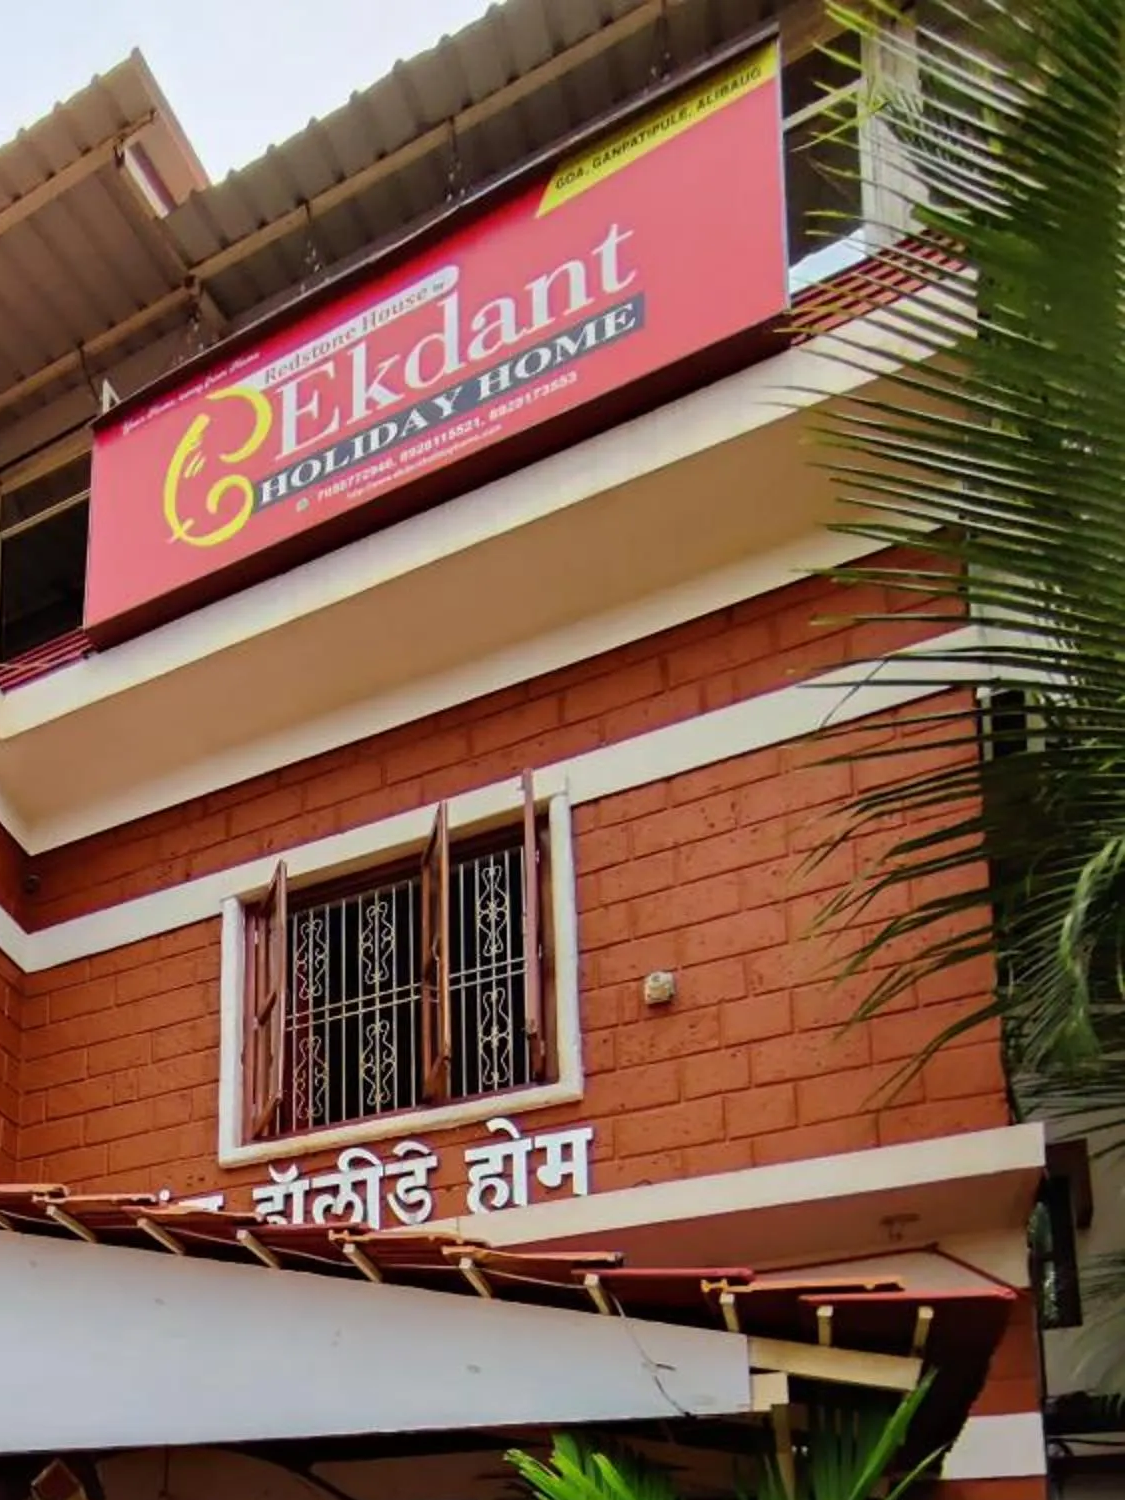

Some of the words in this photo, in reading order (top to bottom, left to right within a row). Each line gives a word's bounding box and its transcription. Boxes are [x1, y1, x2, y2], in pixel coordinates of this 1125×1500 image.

[259, 385, 464, 504] HOLIDAY
[478, 303, 637, 399] HOME
[263, 327, 356, 384] Redstone
[362, 287, 428, 331] House
[274, 223, 637, 461] Ekdant
[465, 1117, 593, 1214] होम
